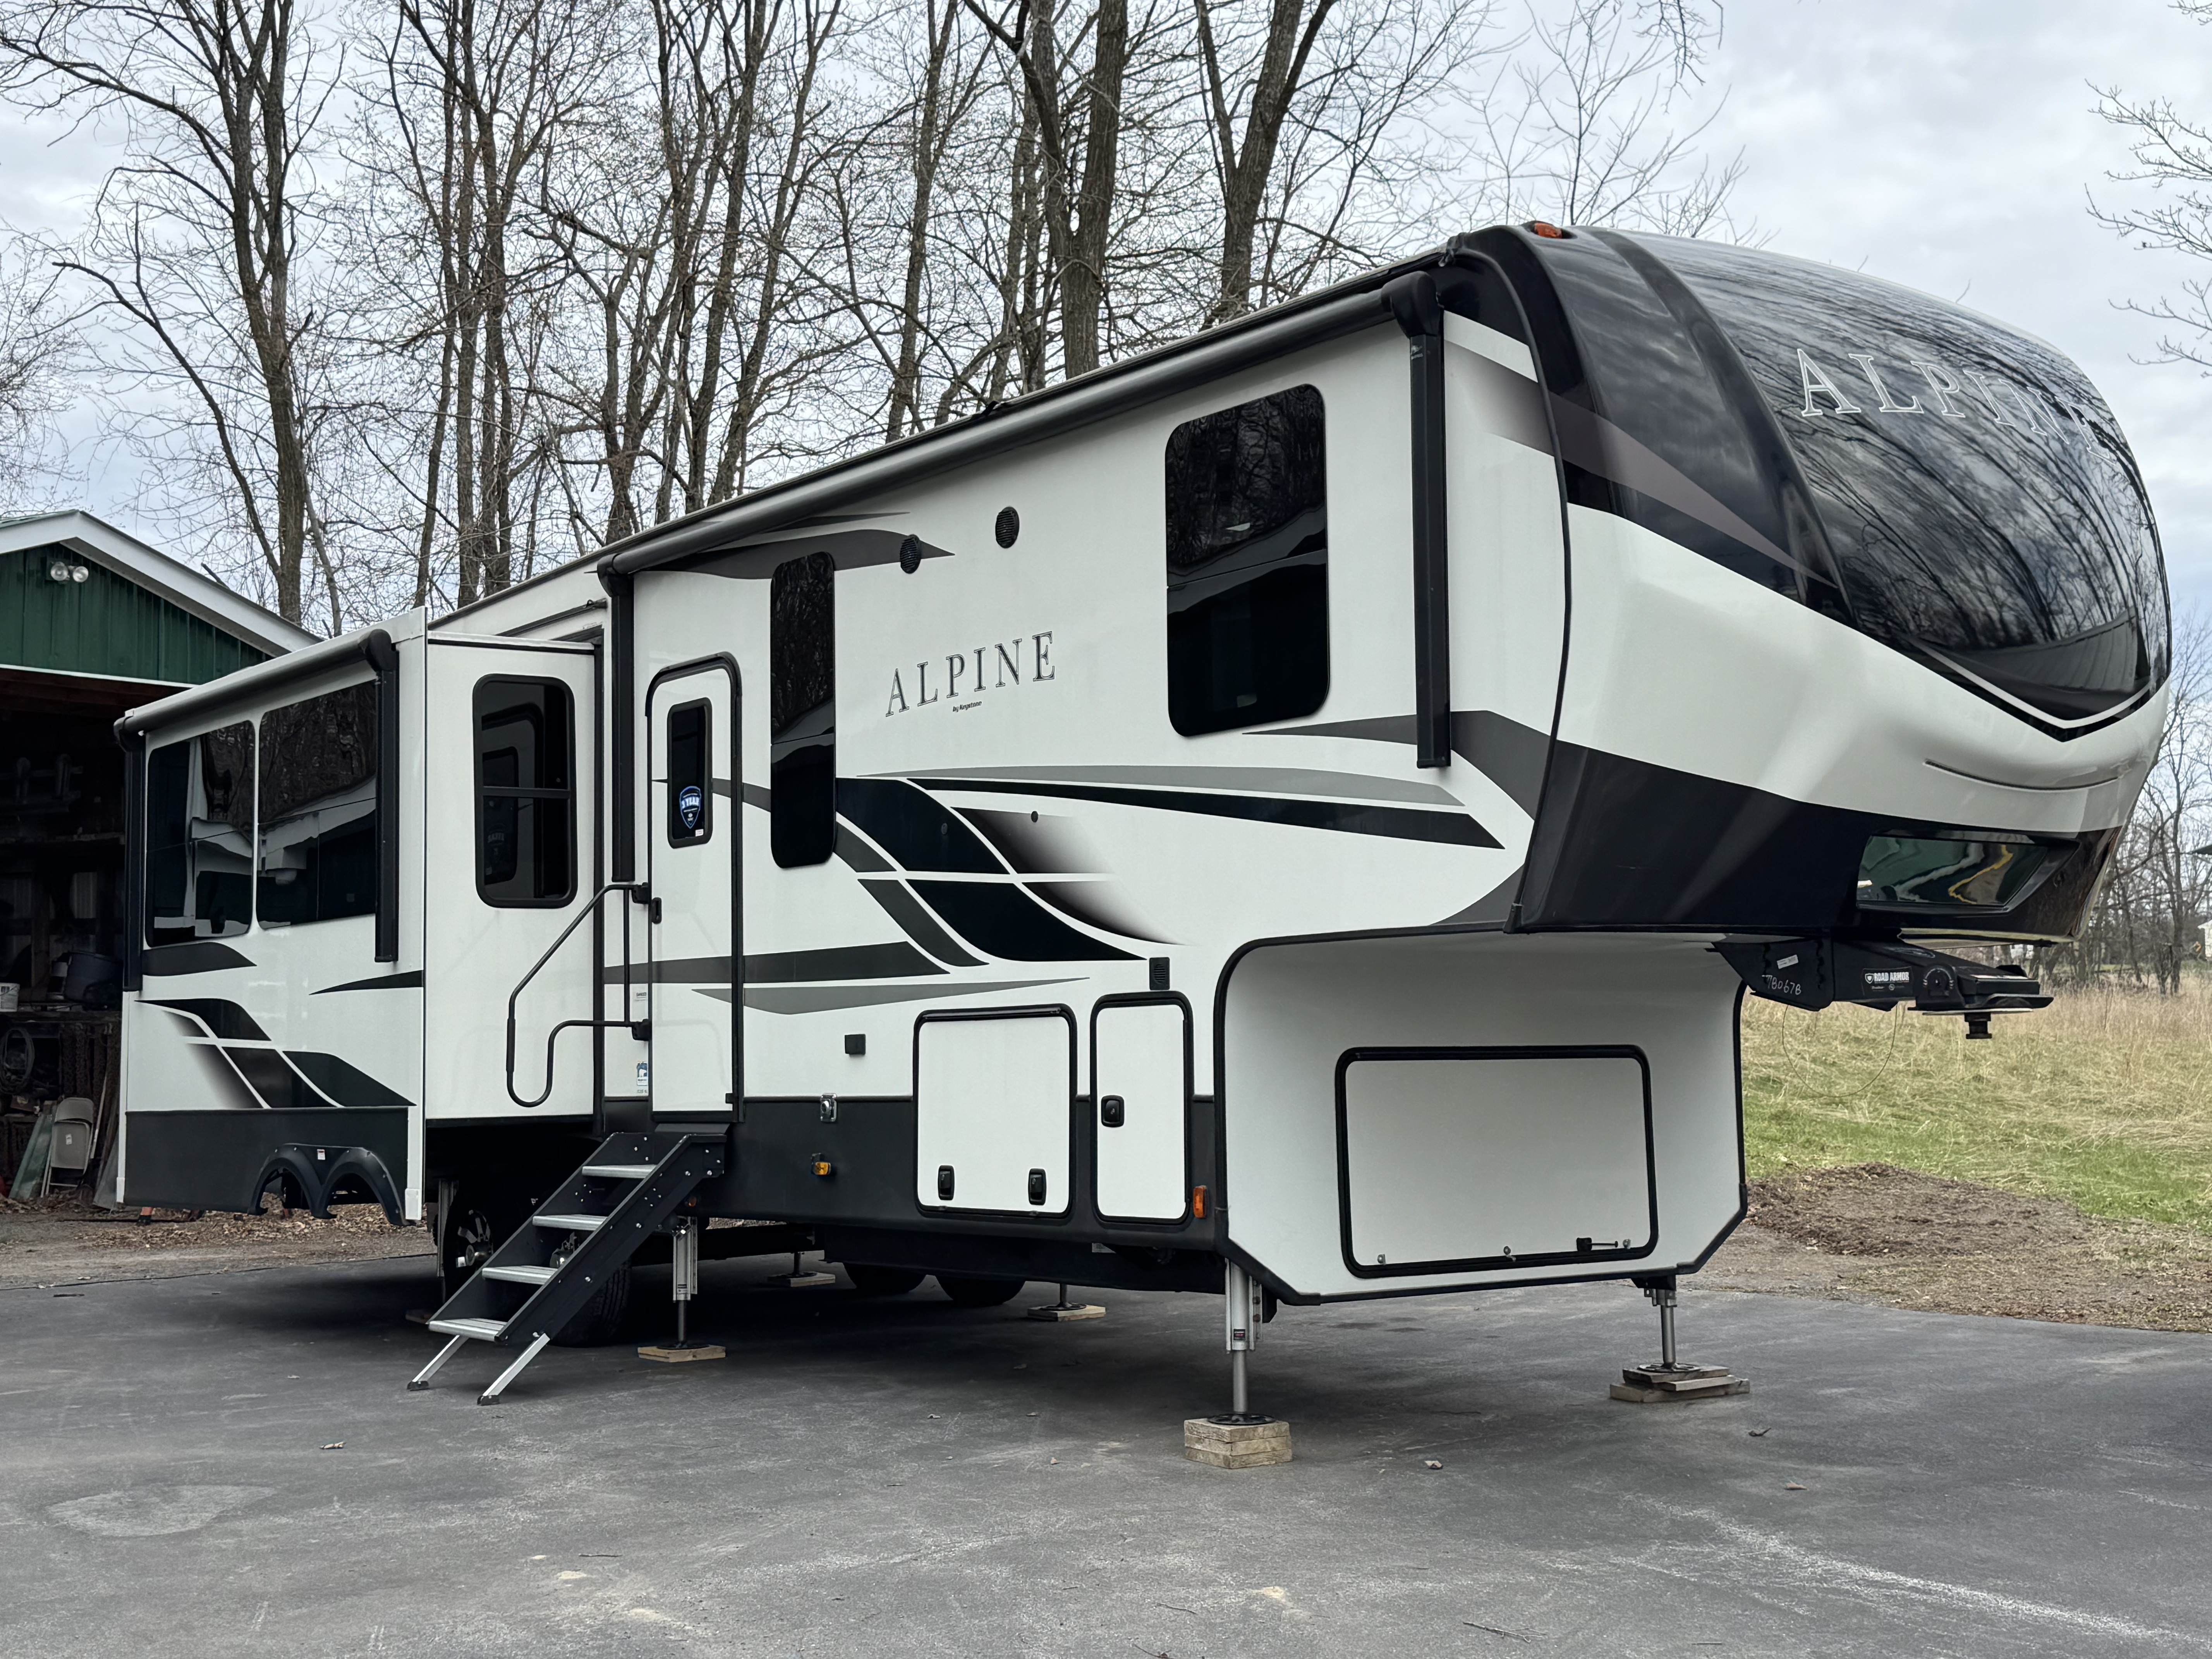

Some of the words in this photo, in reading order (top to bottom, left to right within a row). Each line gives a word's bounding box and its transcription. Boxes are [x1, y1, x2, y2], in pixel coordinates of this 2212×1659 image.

[1797, 348, 2116, 465] ALPINE
[885, 631, 1055, 717] ALPINE
[1874, 972, 1889, 982] ROAD
[1889, 972, 1910, 981] ARMOR
